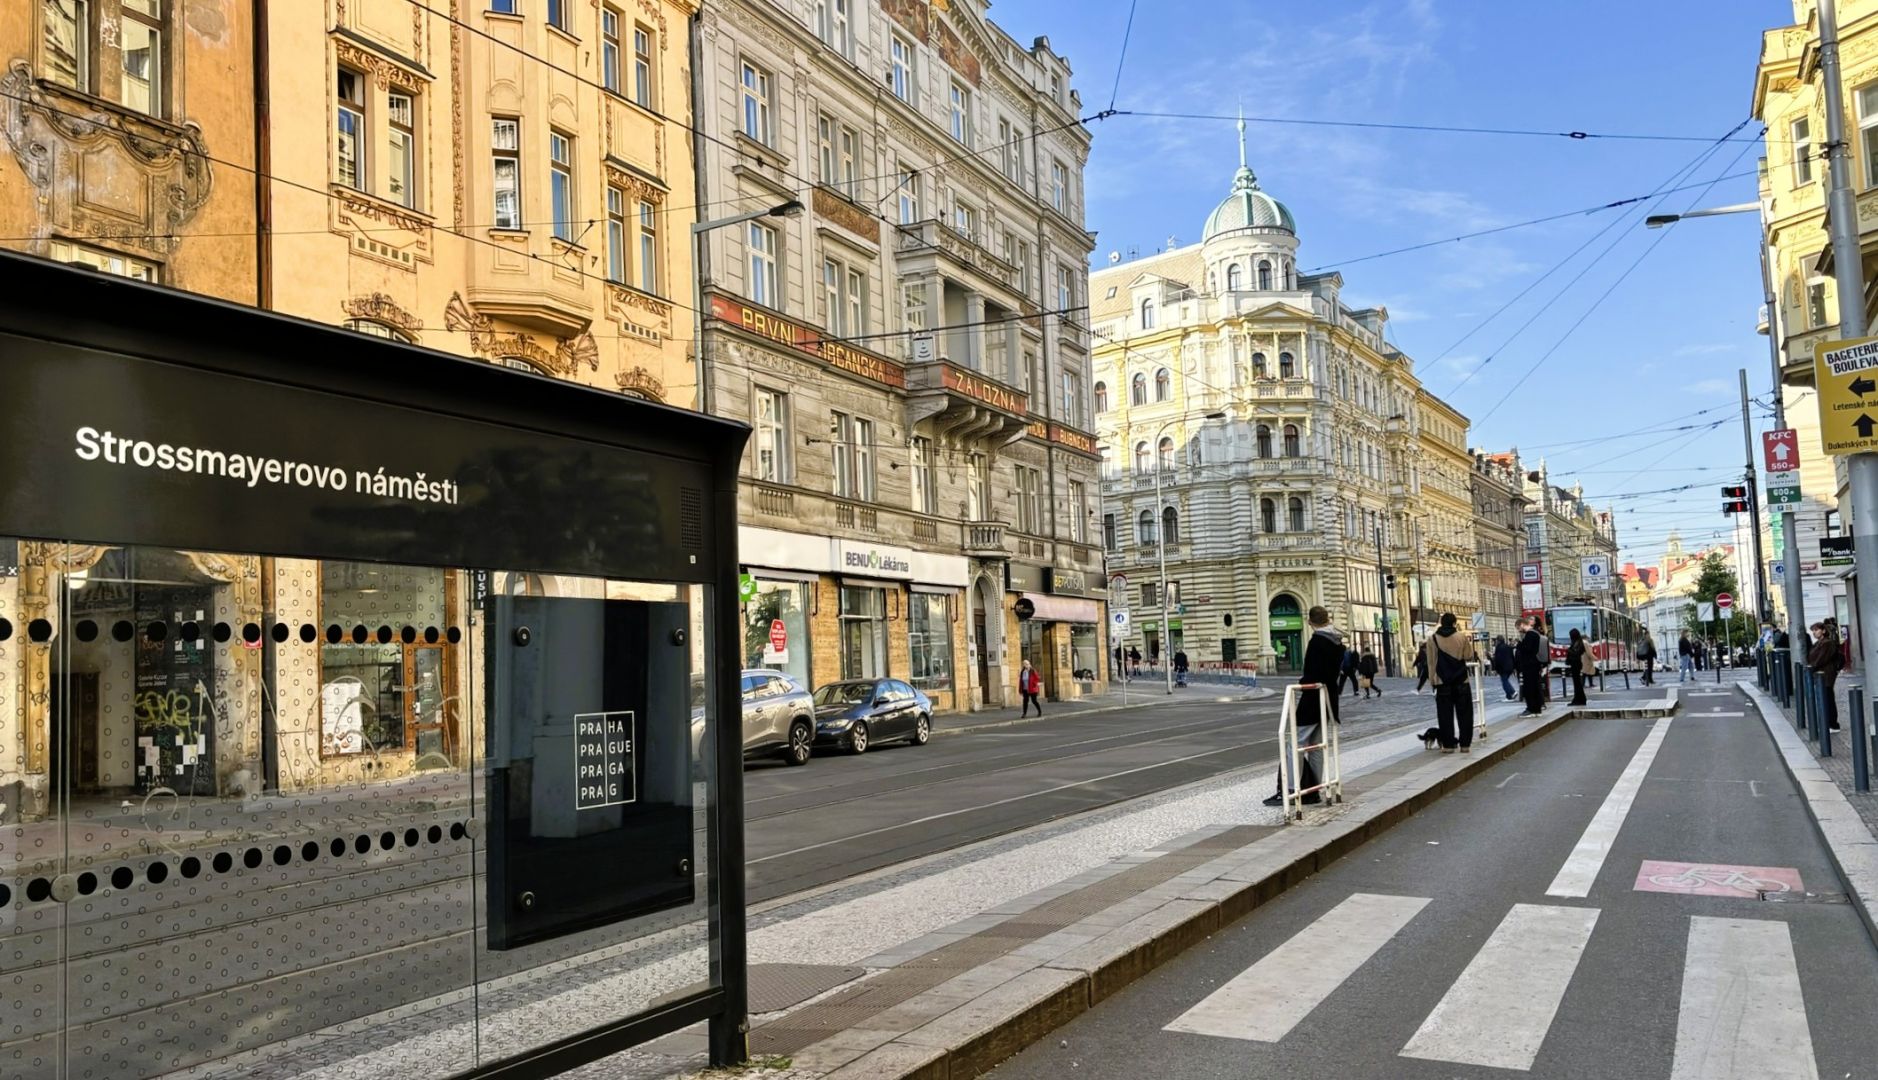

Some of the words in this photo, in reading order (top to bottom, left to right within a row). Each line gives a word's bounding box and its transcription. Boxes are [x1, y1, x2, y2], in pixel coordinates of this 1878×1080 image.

[1826, 342, 1878, 364] BAGETERIE
[1833, 400, 1866, 411] Letenské
[1768, 431, 1791, 441] KFC
[1828, 440, 1868, 450] Dukelských
[75, 427, 348, 490] Strossmayerovo
[1771, 462, 1788, 470] 550
[846, 552, 869, 568] BENU
[879, 556, 909, 572] Lékárna
